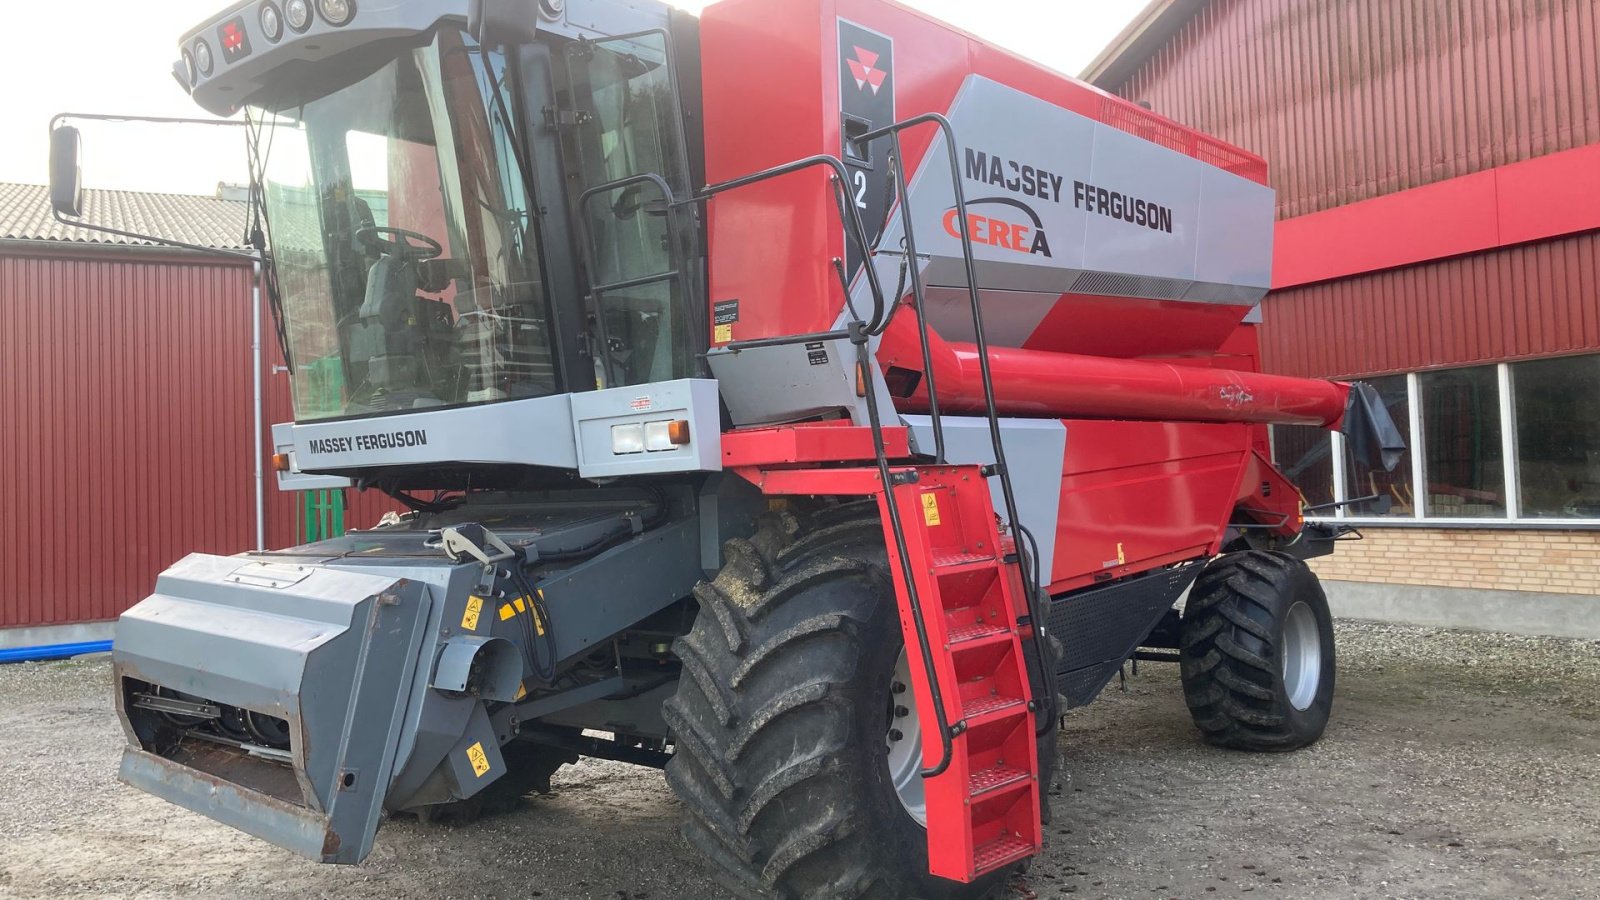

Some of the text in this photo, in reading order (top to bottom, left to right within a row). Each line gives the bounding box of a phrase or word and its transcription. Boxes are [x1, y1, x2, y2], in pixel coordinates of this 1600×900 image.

[854, 170, 867, 209] 2
[1073, 180, 1172, 233] FERGUSON
[942, 207, 1052, 258] CEREA
[309, 429, 427, 455] MASSEY FERGUSON
